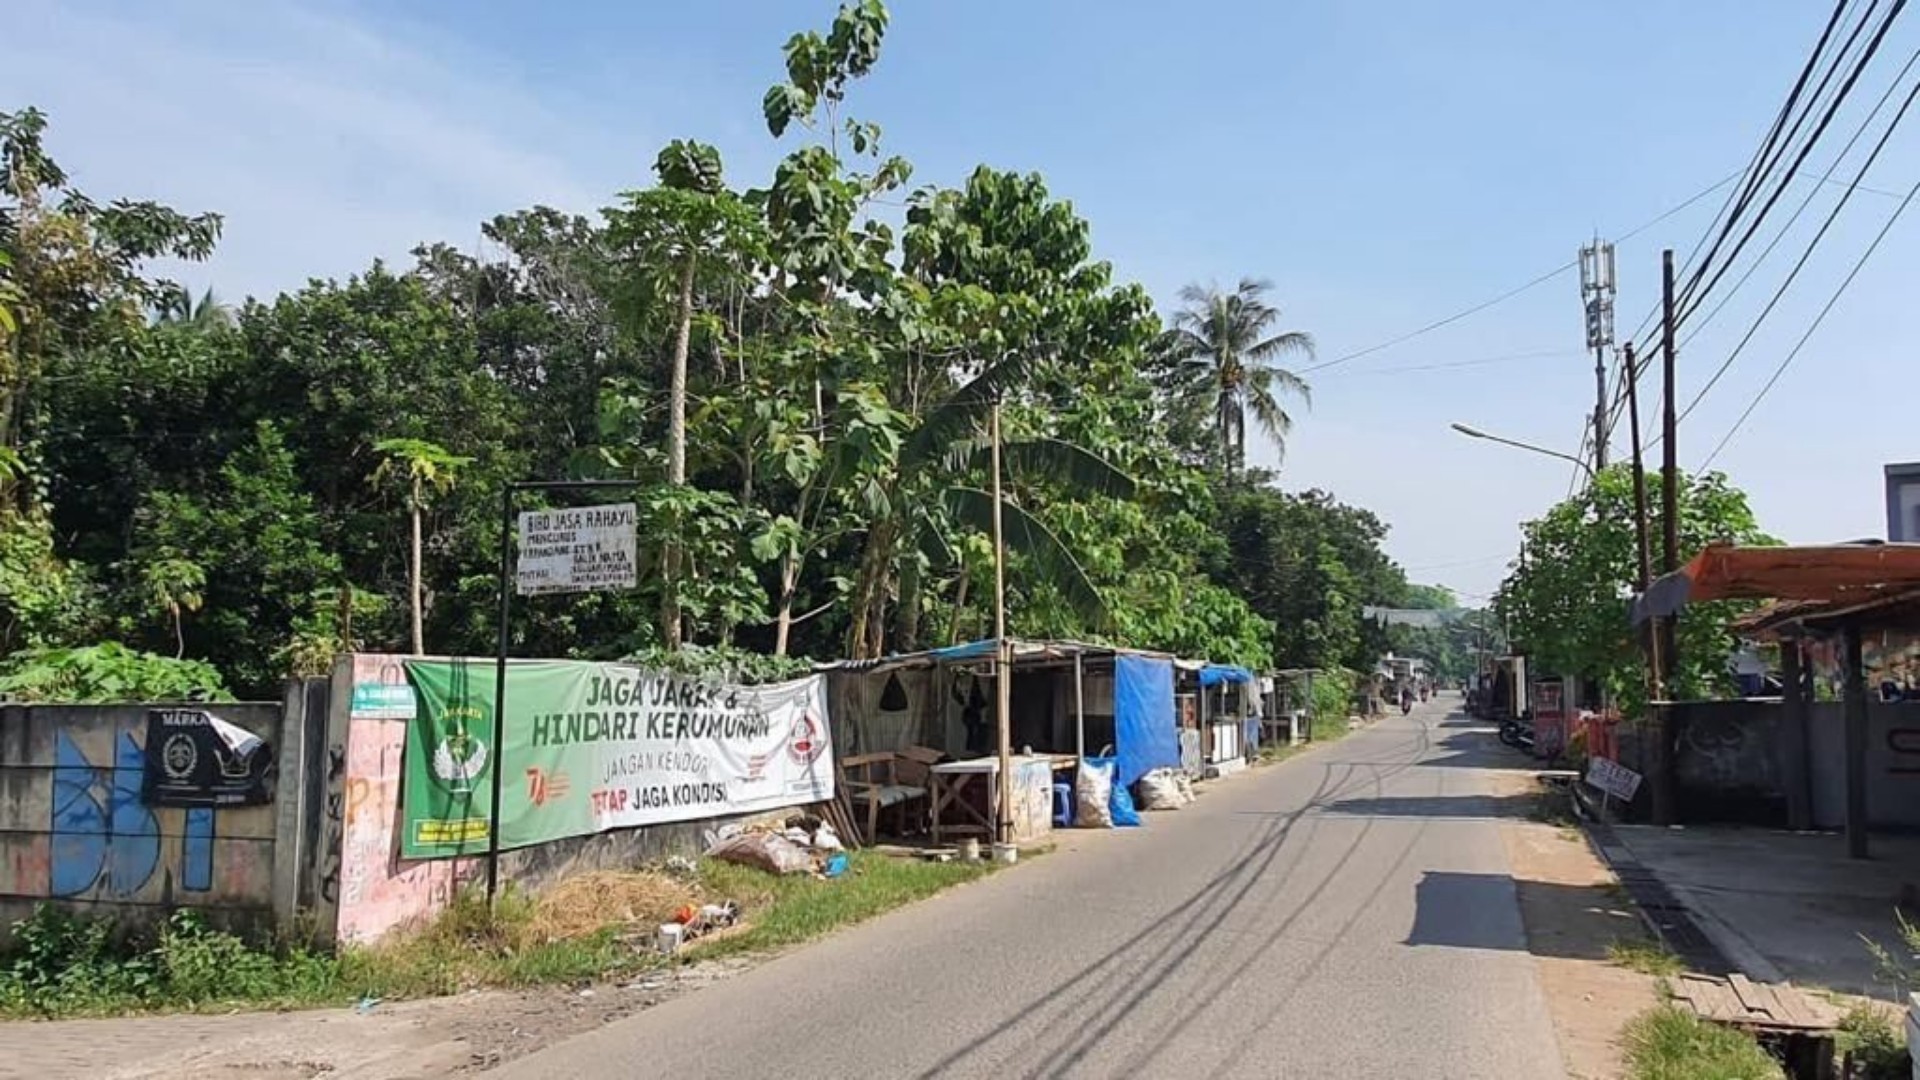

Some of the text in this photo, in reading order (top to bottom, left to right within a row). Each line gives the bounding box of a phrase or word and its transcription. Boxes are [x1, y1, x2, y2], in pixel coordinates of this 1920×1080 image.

[553, 513, 582, 530] JASA
[586, 509, 633, 528] RAHAYU
[586, 677, 645, 706] JAGA
[532, 712, 770, 746] HINDARI KERUMUNAN
[604, 755, 654, 783] JANGAN
[632, 784, 668, 811] JAGA
[672, 781, 727, 807] KONDISI
